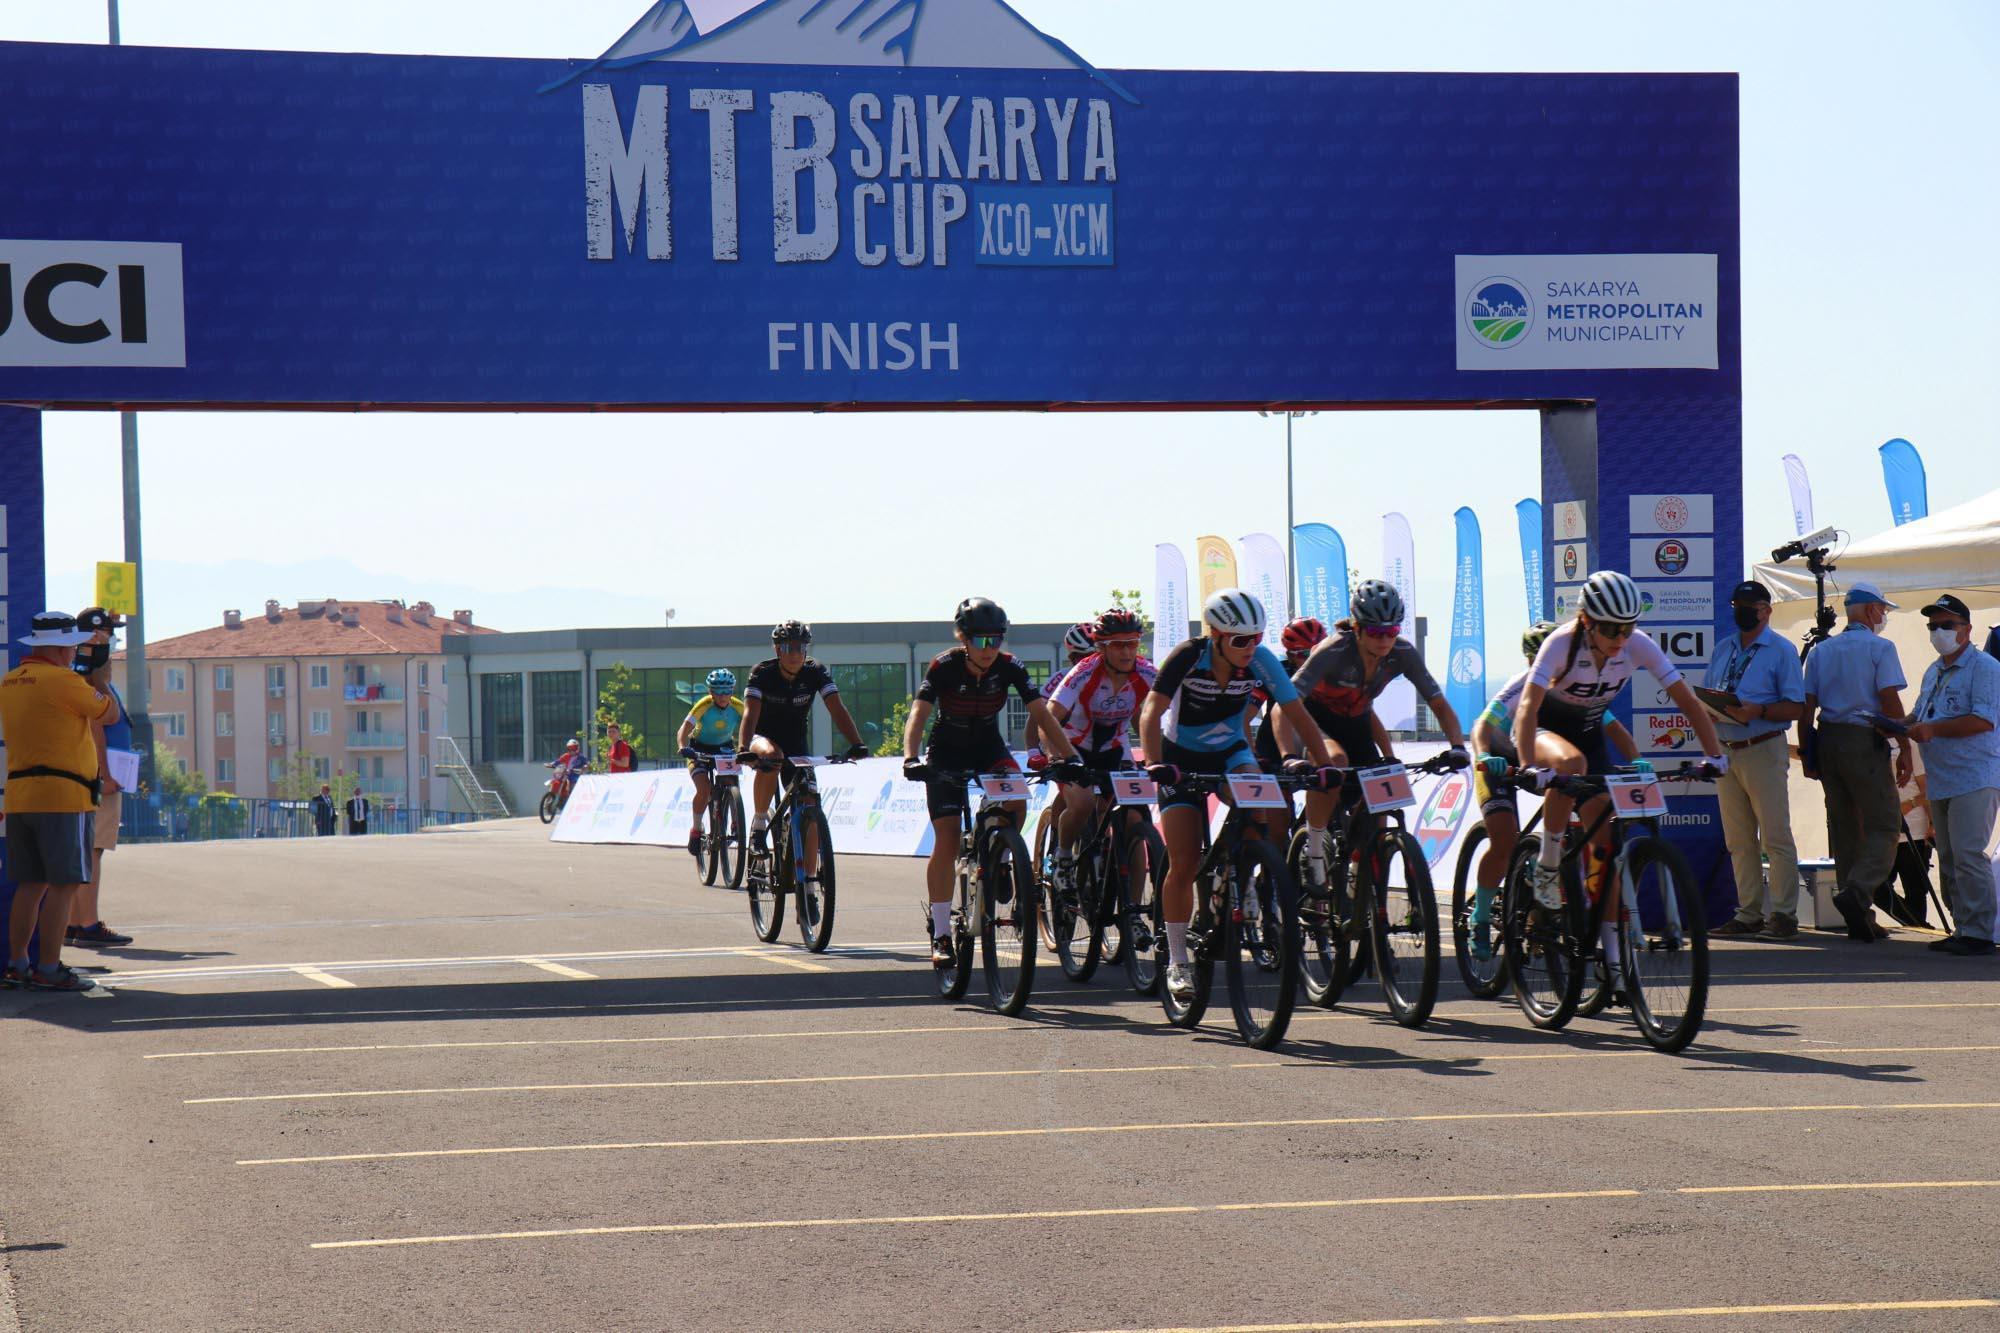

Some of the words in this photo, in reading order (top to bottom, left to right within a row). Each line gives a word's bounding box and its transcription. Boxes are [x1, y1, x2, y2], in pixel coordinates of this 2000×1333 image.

[583, 84, 838, 263] MTB
[849, 93, 1117, 181] SAKARYA
[855, 182, 966, 265] CUP
[980, 203, 1108, 256] XCO-XCM
[1547, 281, 1640, 297] SAKARYA
[0, 263, 148, 344] CI
[1547, 303, 1702, 319] METROPOLITAN
[1547, 325, 1685, 341] MUNICIPALITY
[769, 322, 958, 370] FINISH
[1650, 716, 1675, 728] Red
[1129, 782, 1143, 795] 5
[1248, 784, 1263, 797] 7
[1380, 780, 1393, 797] 1
[1630, 788, 1646, 804] 6
